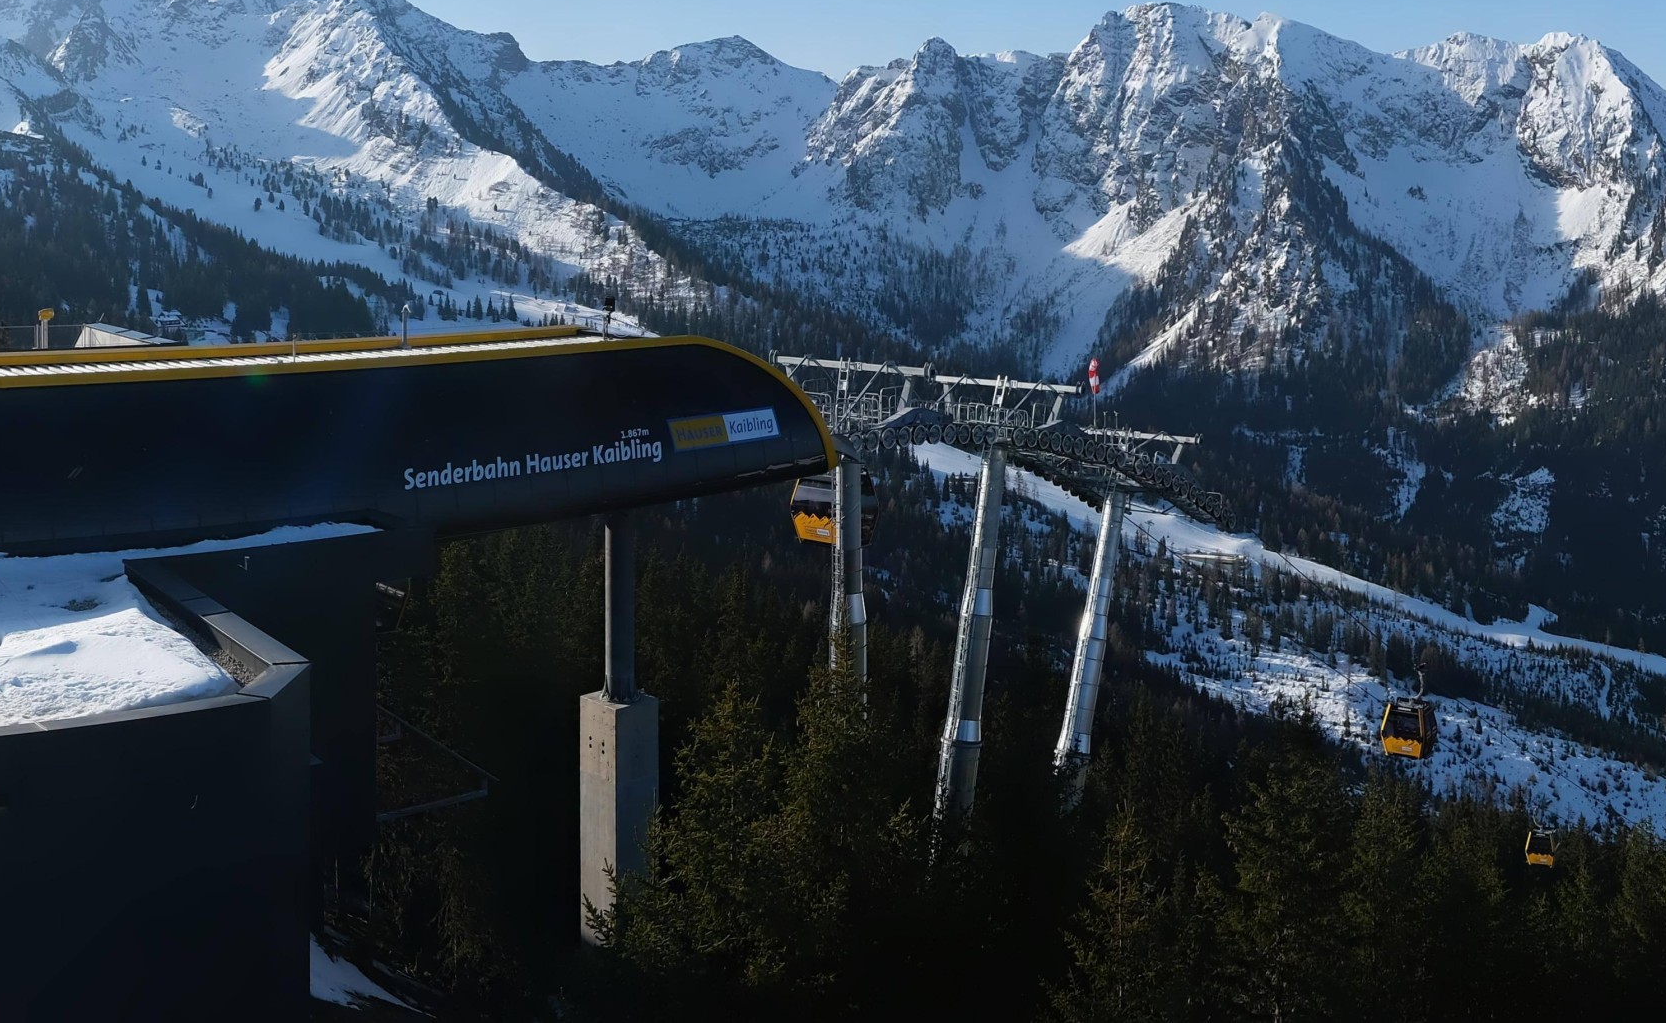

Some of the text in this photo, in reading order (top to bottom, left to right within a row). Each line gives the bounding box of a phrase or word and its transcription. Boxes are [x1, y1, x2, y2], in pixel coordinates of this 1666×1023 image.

[620, 428, 649, 439] 1.867m
[729, 417, 774, 434] Kaibling
[404, 438, 663, 491] Senderbahn Hauser Kaibling
